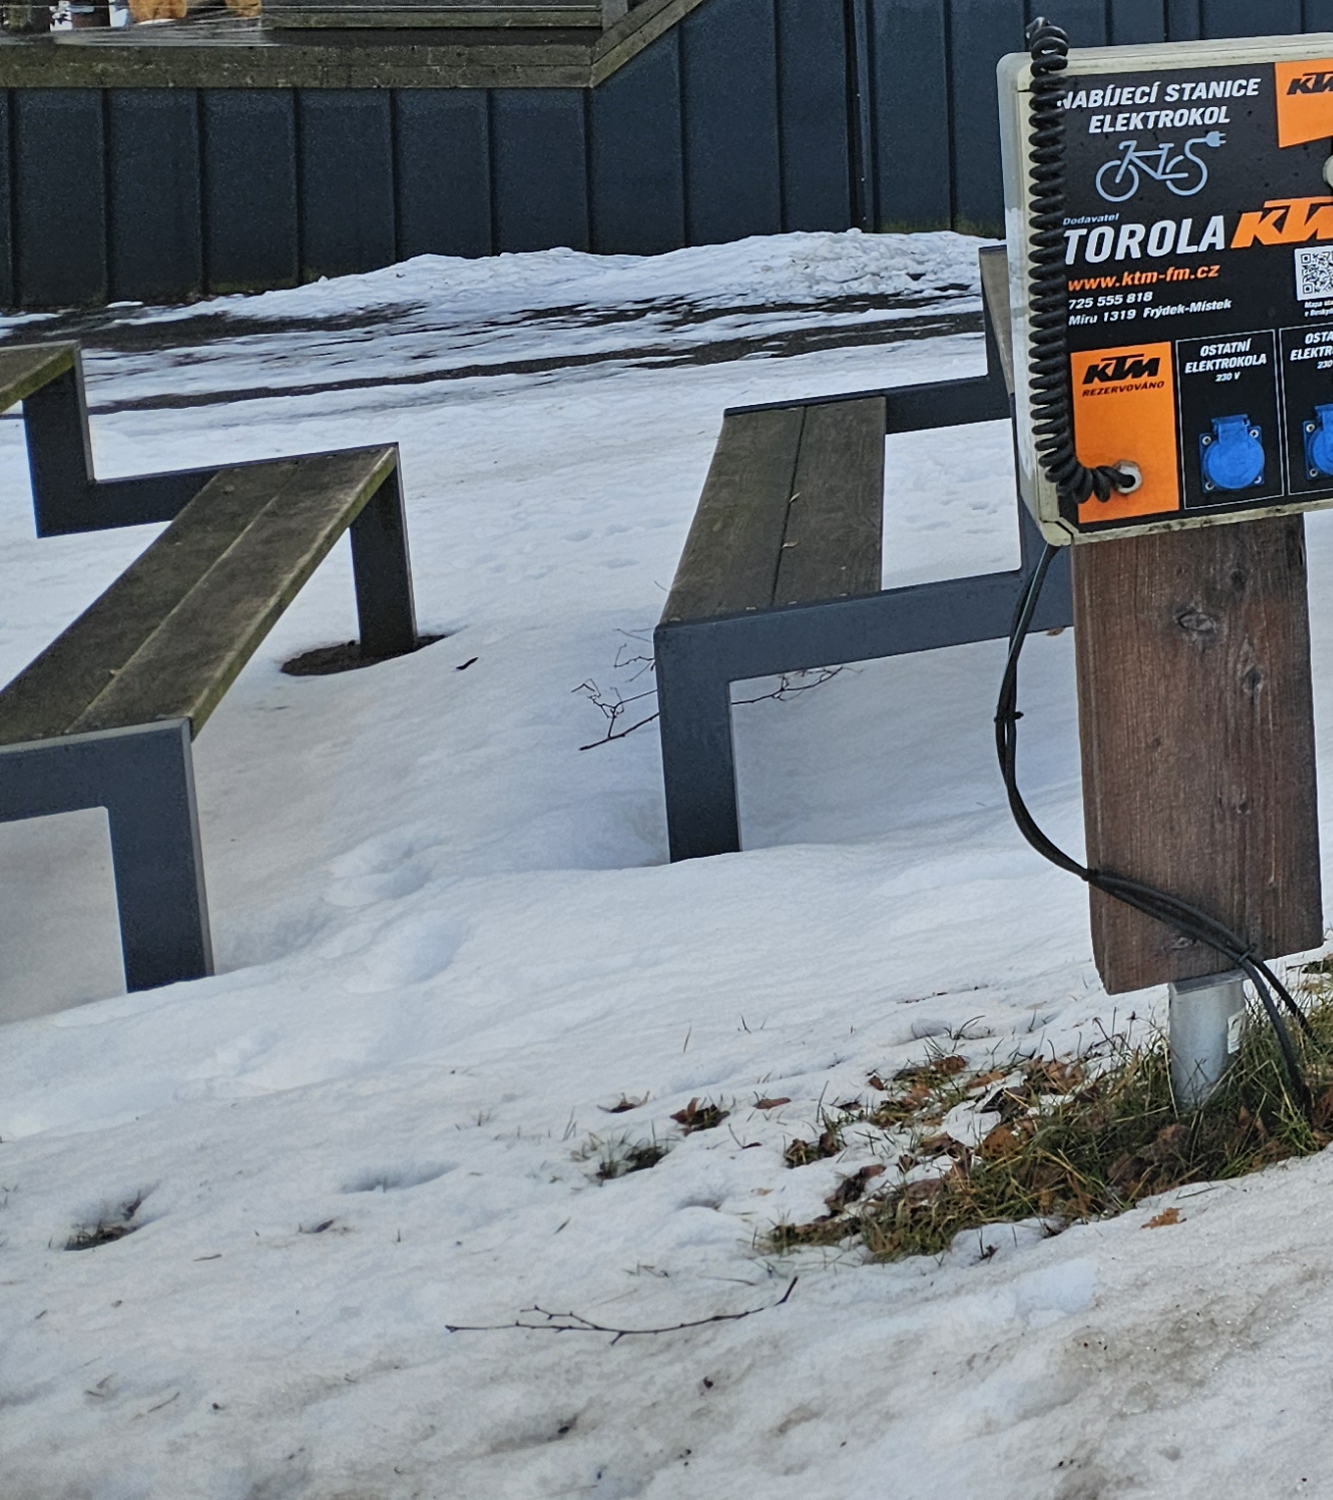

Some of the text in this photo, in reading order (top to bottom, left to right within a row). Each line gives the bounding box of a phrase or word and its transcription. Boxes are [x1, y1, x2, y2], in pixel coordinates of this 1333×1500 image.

[1164, 77, 1262, 102] STANICE
[1088, 105, 1231, 134] ELEKTROKOL
[1062, 212, 1120, 227] Dodavatel
[1063, 215, 1226, 266] TOROLA
[1067, 264, 1221, 292] www.ktm-fm.cz
[1068, 291, 1153, 311] 725 555 818
[1103, 309, 1137, 323] 1319
[1142, 298, 1233, 320] Frýdek-Místek
[1200, 338, 1252, 357] OSTATNÍ
[1082, 354, 1161, 385] KTM
[1184, 354, 1267, 374] ELEKTROKOLA
[1316, 360, 1333, 370] 230
[1215, 371, 1241, 382] 230 V
[1082, 380, 1165, 397] REZERVOVÁNO
